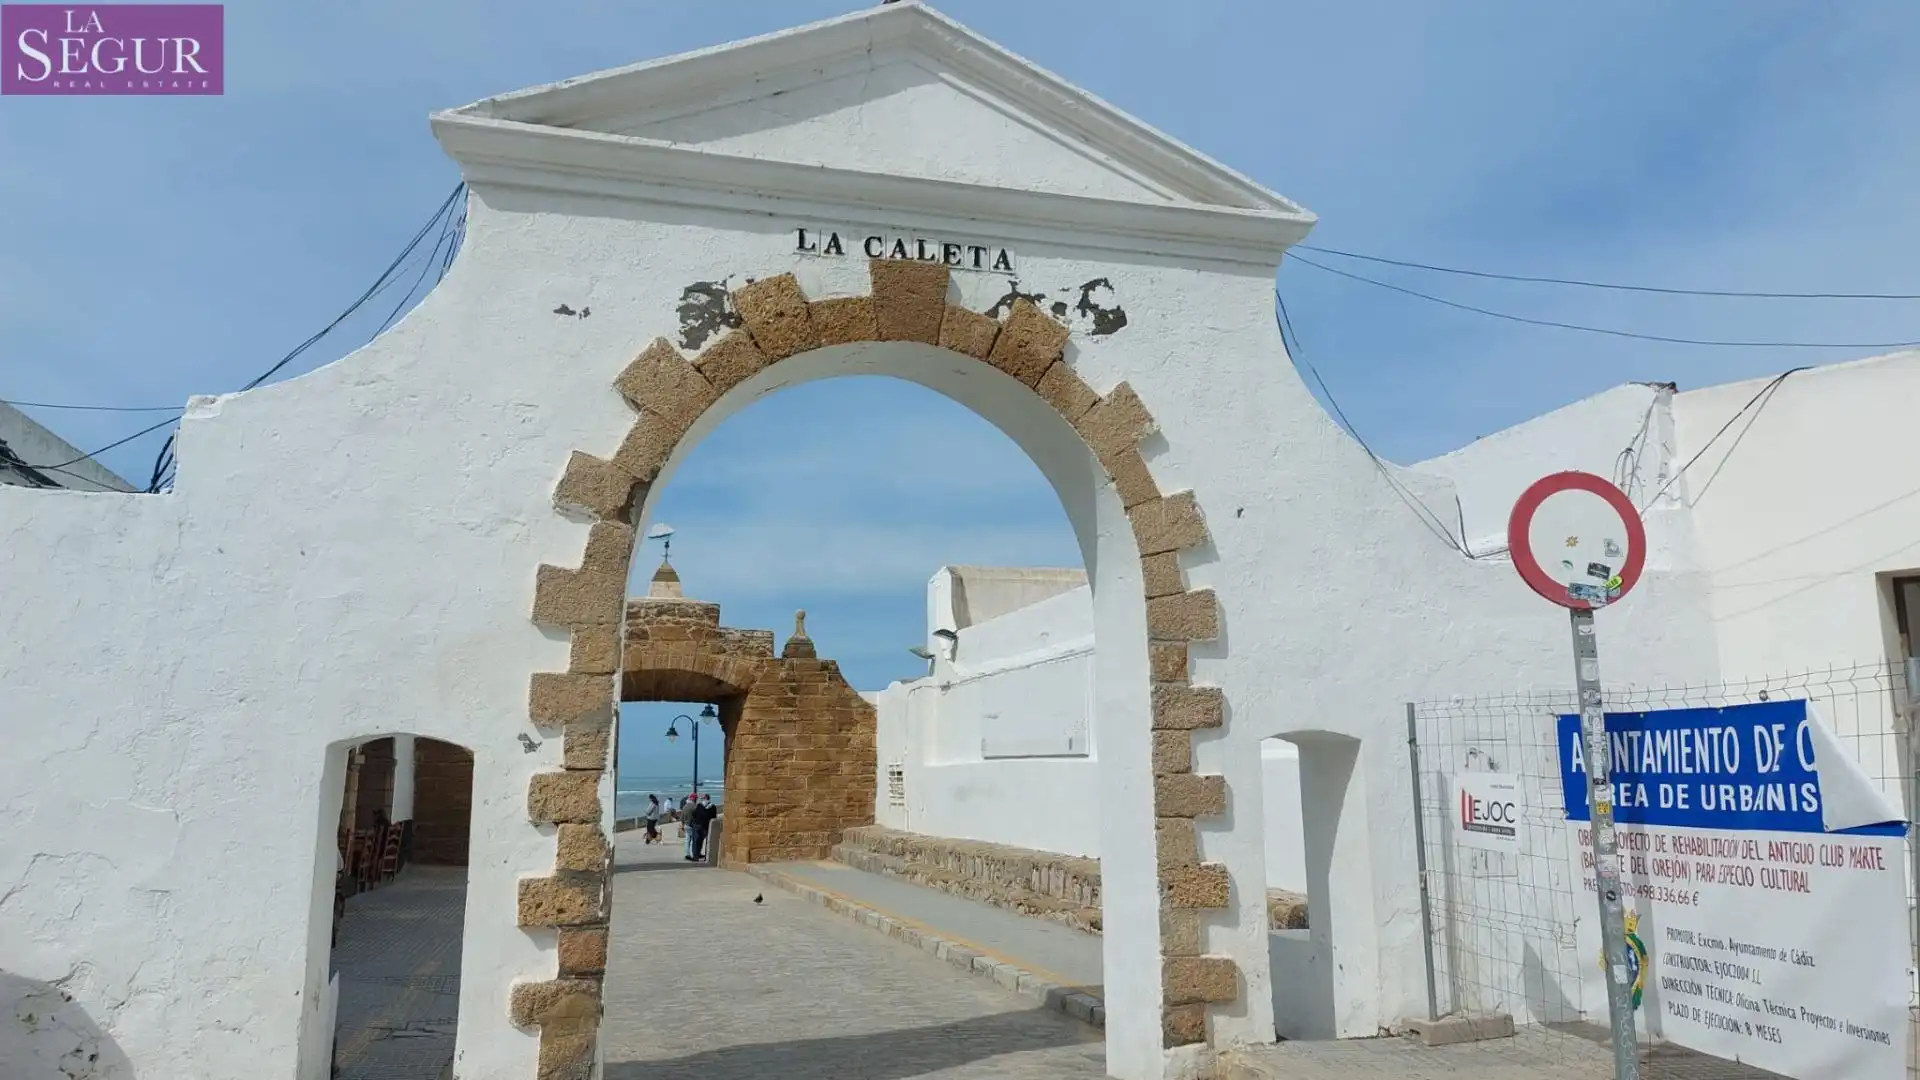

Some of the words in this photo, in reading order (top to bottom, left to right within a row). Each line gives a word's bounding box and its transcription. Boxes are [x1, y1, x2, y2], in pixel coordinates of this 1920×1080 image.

[795, 228, 844, 255] LA
[864, 236, 1012, 270] CALETA
[1571, 726, 1740, 774] AUNTAMIENTO
[1753, 723, 1786, 773] DE
[1473, 799, 1515, 823] EJOC
[1585, 782, 1649, 808] REA
[1659, 783, 1689, 810] DE
[1655, 834, 1667, 853] DE
[1741, 839, 1763, 861] DEL
[1768, 840, 1815, 865] ANTIGUO
[1819, 844, 1844, 867] CLUB
[1848, 845, 1886, 870] MARTE
[1630, 856, 1648, 875] DEL
[1652, 856, 1691, 886] OREJÓN)
[1696, 862, 1716, 883] PARA
[1760, 867, 1810, 893] CULTURAL
[1692, 891, 1700, 907] €
[1698, 933, 1727, 951] Excmo.
[1729, 937, 1777, 961] Ayuntamiento
[1779, 948, 1788, 962] de
[1791, 948, 1815, 967] Cádiz
[1661, 975, 1703, 997] DIRECCIÓN
[1736, 992, 1761, 1013] Oficina
[1762, 998, 1797, 1020] Técnica
[1800, 1005, 1837, 1030] Proyectos
[1846, 1018, 1891, 1046] Inversiones
[1668, 1000, 1689, 1020] PLAZO
[1692, 1007, 1702, 1023] DE
[1704, 1010, 1744, 1035] EJECUCIÓN:
[1755, 1023, 1782, 1044] MESES
